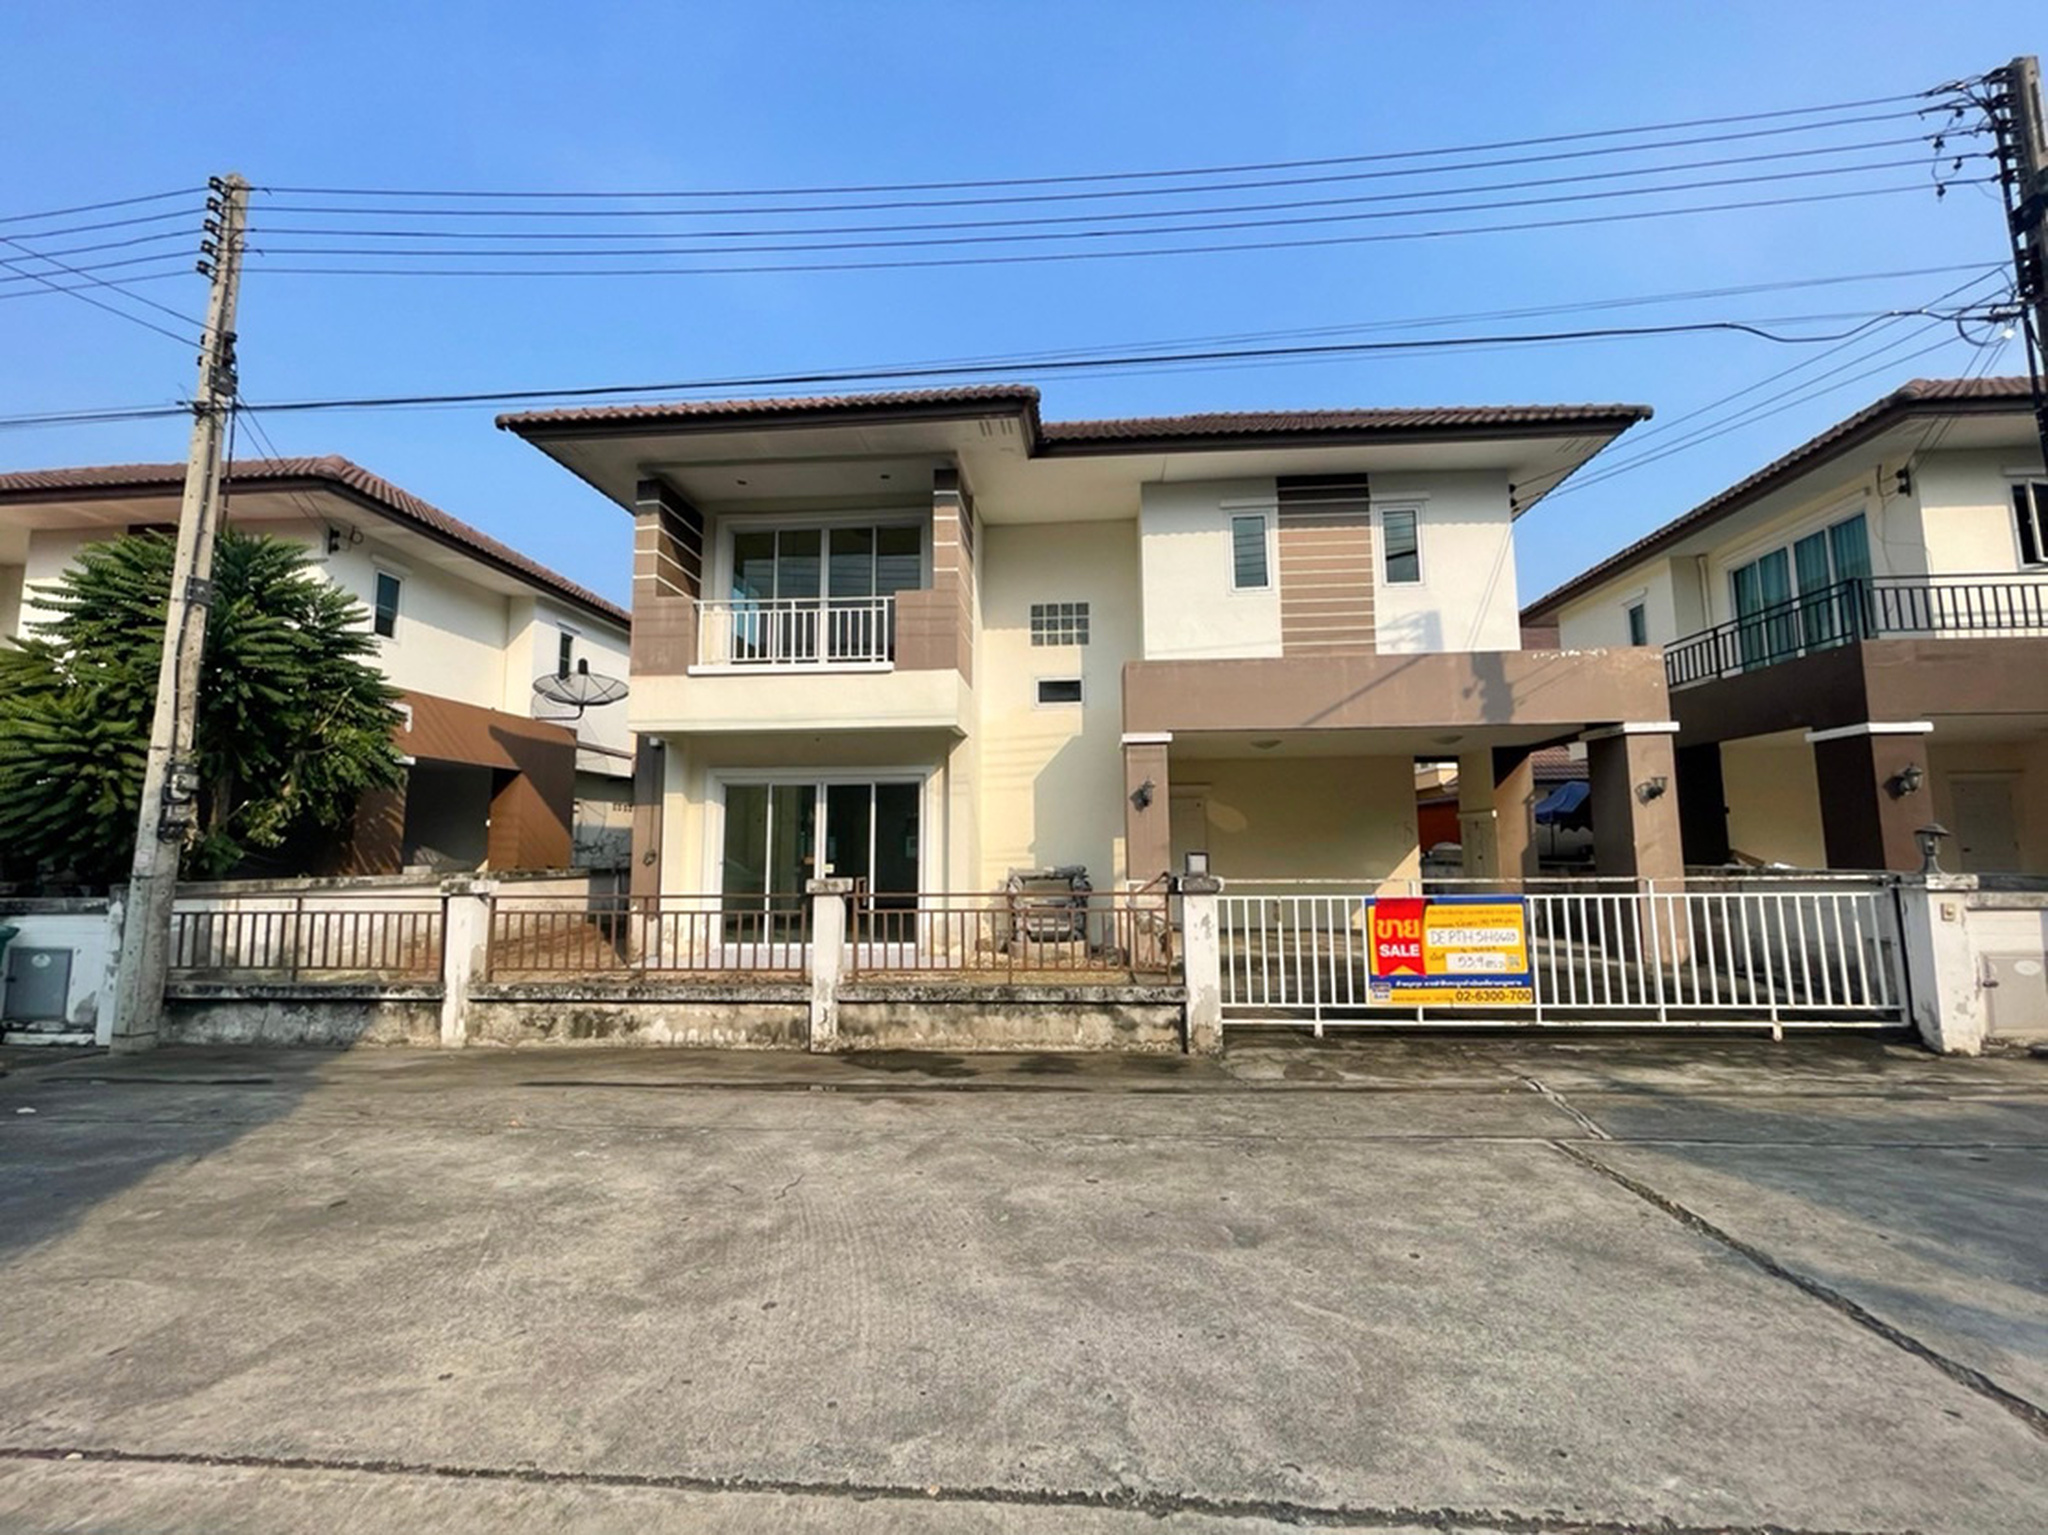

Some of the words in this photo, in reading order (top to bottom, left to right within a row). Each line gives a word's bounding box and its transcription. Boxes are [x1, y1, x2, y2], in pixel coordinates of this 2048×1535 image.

[1376, 919, 1420, 939] ขาย
[1379, 943, 1420, 957] SALE
[1455, 990, 1532, 1001] 02-6300-700
